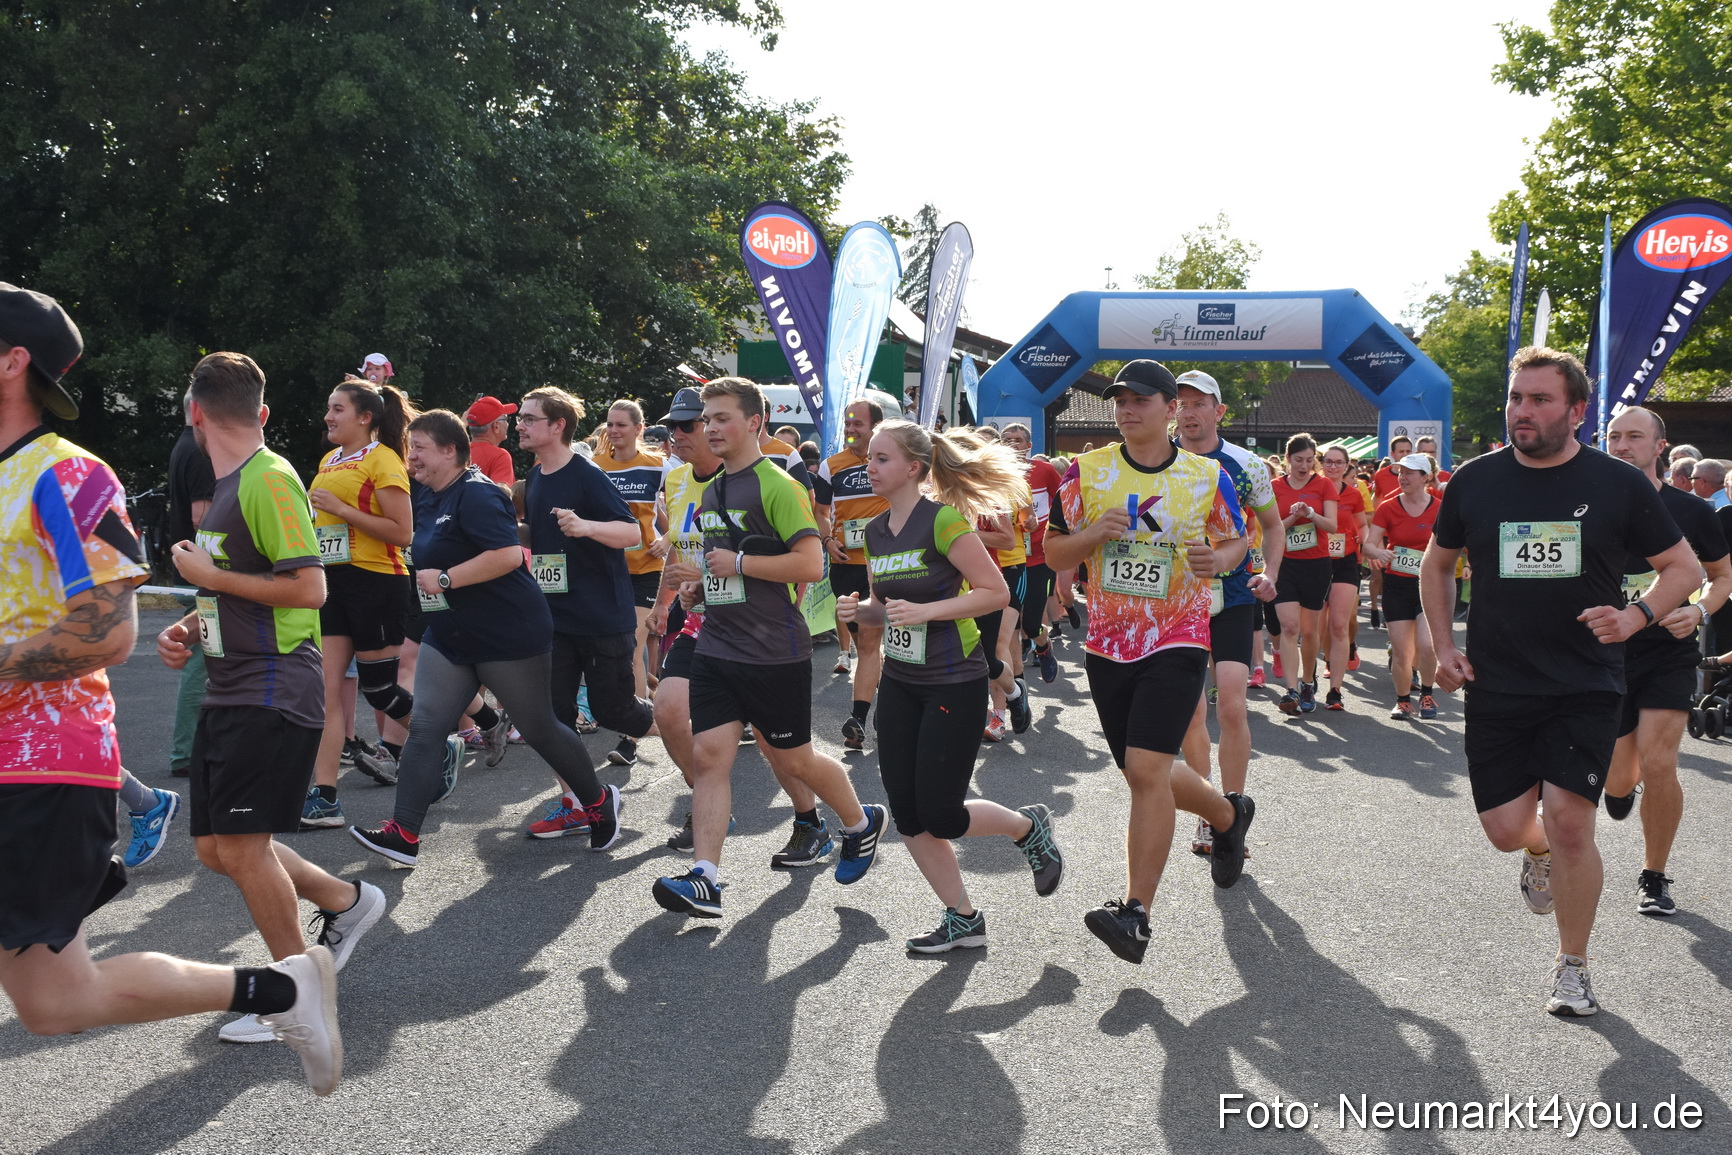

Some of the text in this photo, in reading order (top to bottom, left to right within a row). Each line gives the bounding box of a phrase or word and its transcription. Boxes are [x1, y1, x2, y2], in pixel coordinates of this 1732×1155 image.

[1645, 229, 1729, 259] Hervis
[1655, 254, 1687, 263] SPORTS
[1205, 310, 1233, 318] Fischer
[1183, 325, 1268, 341] firmenlauf
[1027, 352, 1071, 362] Fischer
[320, 537, 342, 554] 577
[1288, 532, 1312, 545] 1027
[1329, 541, 1341, 551] 32
[1515, 542, 1562, 562] 435
[1396, 555, 1421, 568] 1034
[534, 568, 561, 582] 1405
[895, 571, 929, 580] concepts
[1110, 560, 1160, 583] 1325
[706, 575, 728, 592] 297
[887, 625, 911, 648] 339
